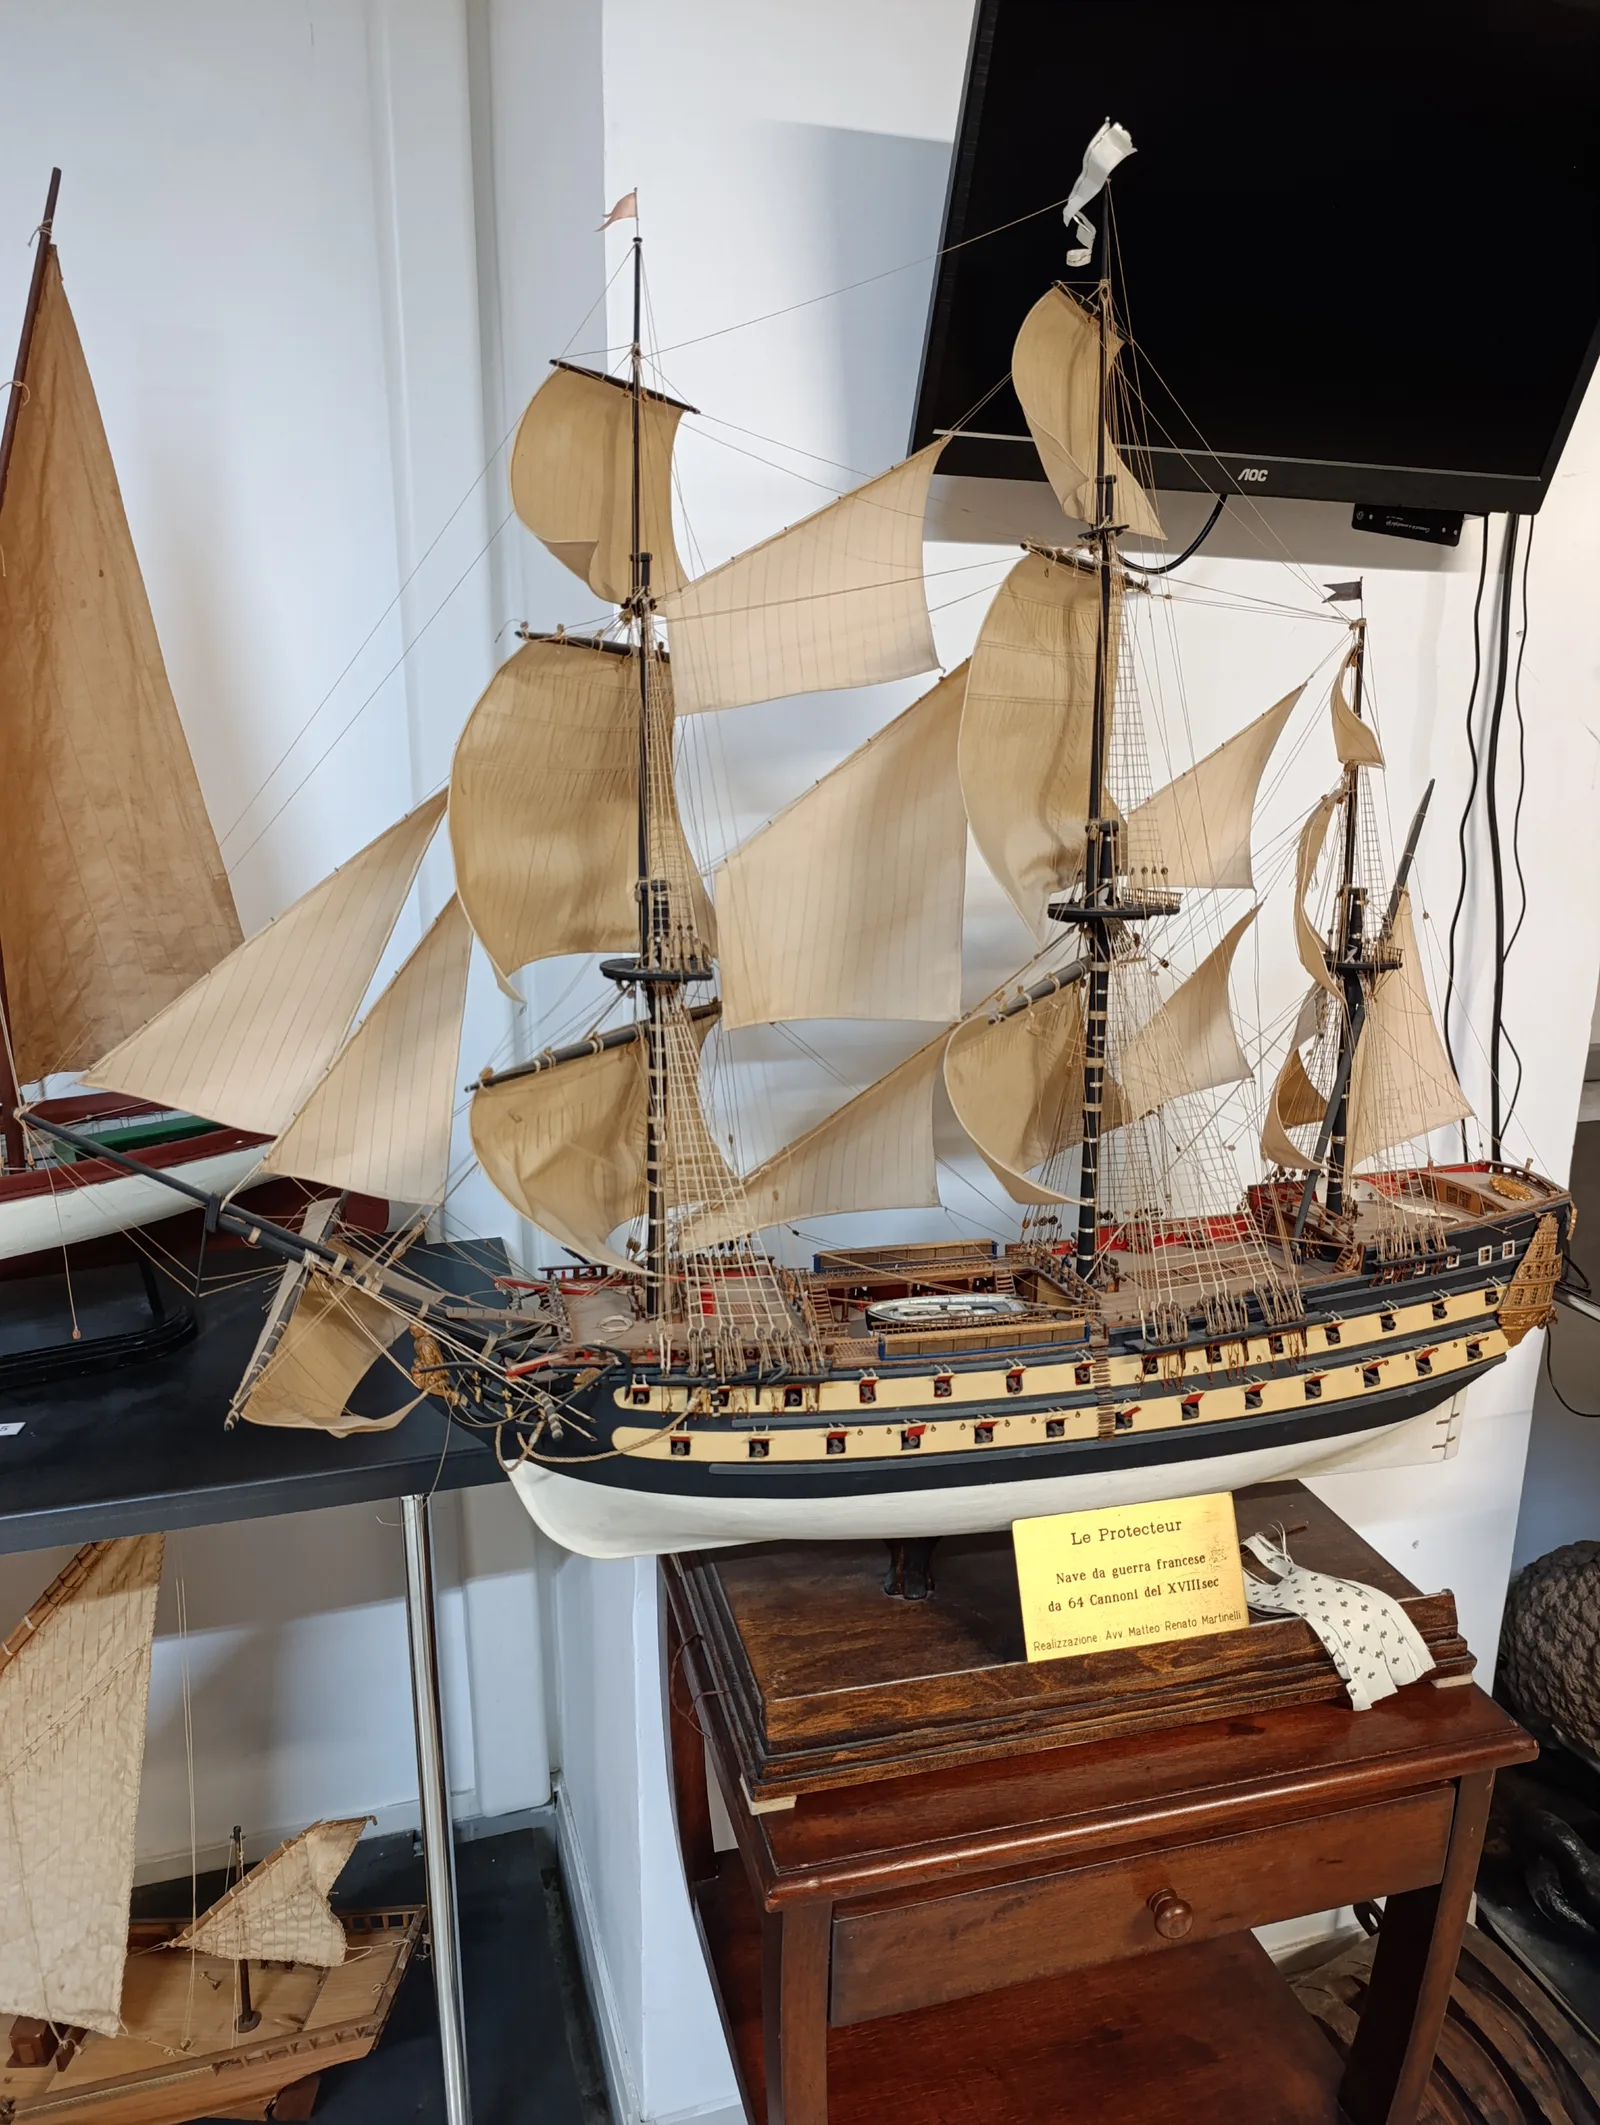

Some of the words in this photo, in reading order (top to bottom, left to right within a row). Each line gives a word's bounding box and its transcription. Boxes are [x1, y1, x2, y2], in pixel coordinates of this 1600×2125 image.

[1238, 468, 1268, 482] AOC
[1071, 1532, 1091, 1546] Le
[1098, 1520, 1182, 1542] Protecteur
[1056, 1573, 1087, 1585] Nave
[1092, 1568, 1106, 1579] da
[1112, 1562, 1151, 1579] guerra
[1157, 1554, 1206, 1570] francese
[1048, 1601, 1062, 1612] da
[1068, 1597, 1084, 1609] 64
[1090, 1588, 1138, 1606] Cannoni
[1144, 1585, 1162, 1598] del
[1033, 1634, 1098, 1652] Realizzazione
[1128, 1623, 1161, 1637] Matteo
[1165, 1617, 1197, 1631] Renato
[1201, 1610, 1242, 1625] Martinelli
